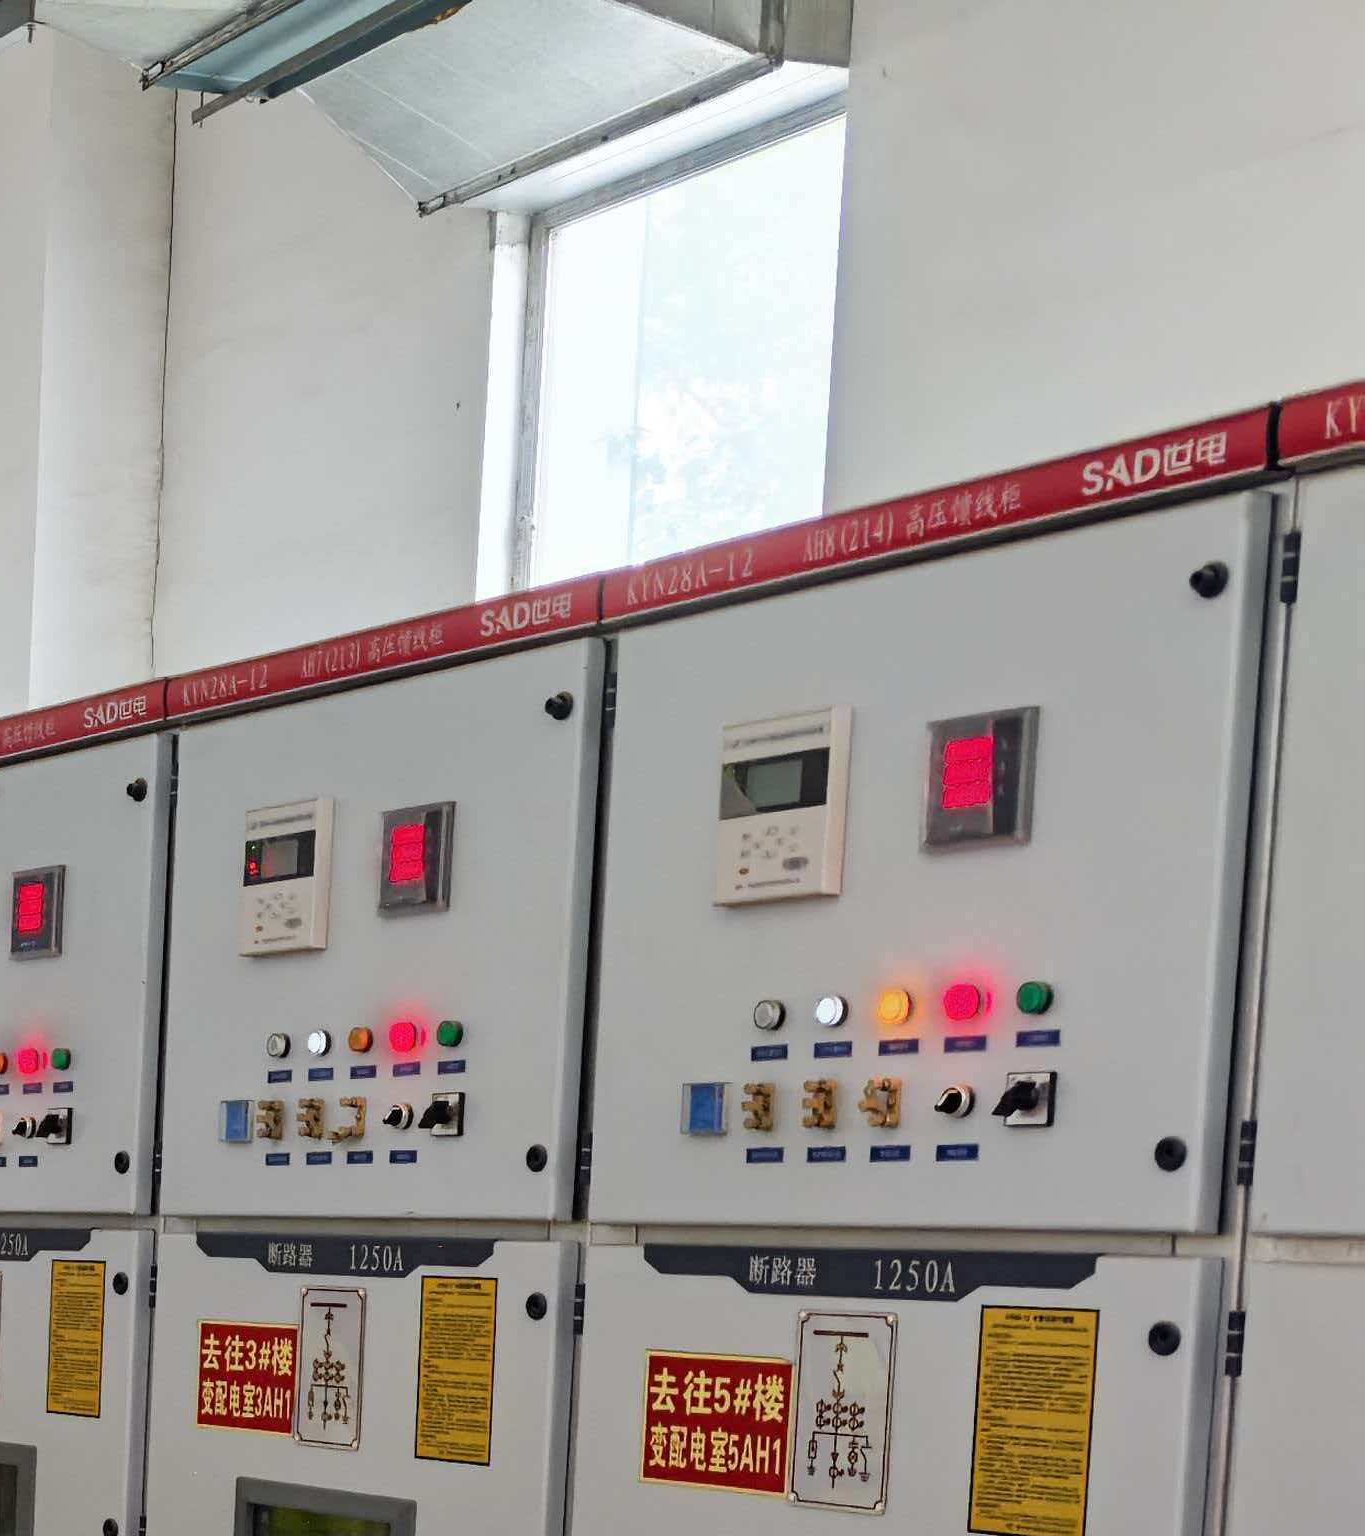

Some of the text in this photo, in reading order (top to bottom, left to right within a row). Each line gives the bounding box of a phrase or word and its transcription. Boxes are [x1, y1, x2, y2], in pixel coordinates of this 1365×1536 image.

[626, 547, 755, 607] KYN28A-12
[802, 509, 895, 564] AH8(214)
[905, 481, 1022, 538] 高压馈线柜
[182, 663, 269, 707] KYN28A-12
[268, 1242, 404, 1272] 断路器 1250A
[748, 1254, 956, 1293] 断路器 1250A
[201, 1333, 294, 1377] 去往3#楼
[201, 1377, 292, 1420] 变配电室3AH1
[649, 1366, 785, 1423] 去往5#楼
[648, 1421, 782, 1477] 变配电室5AH1
